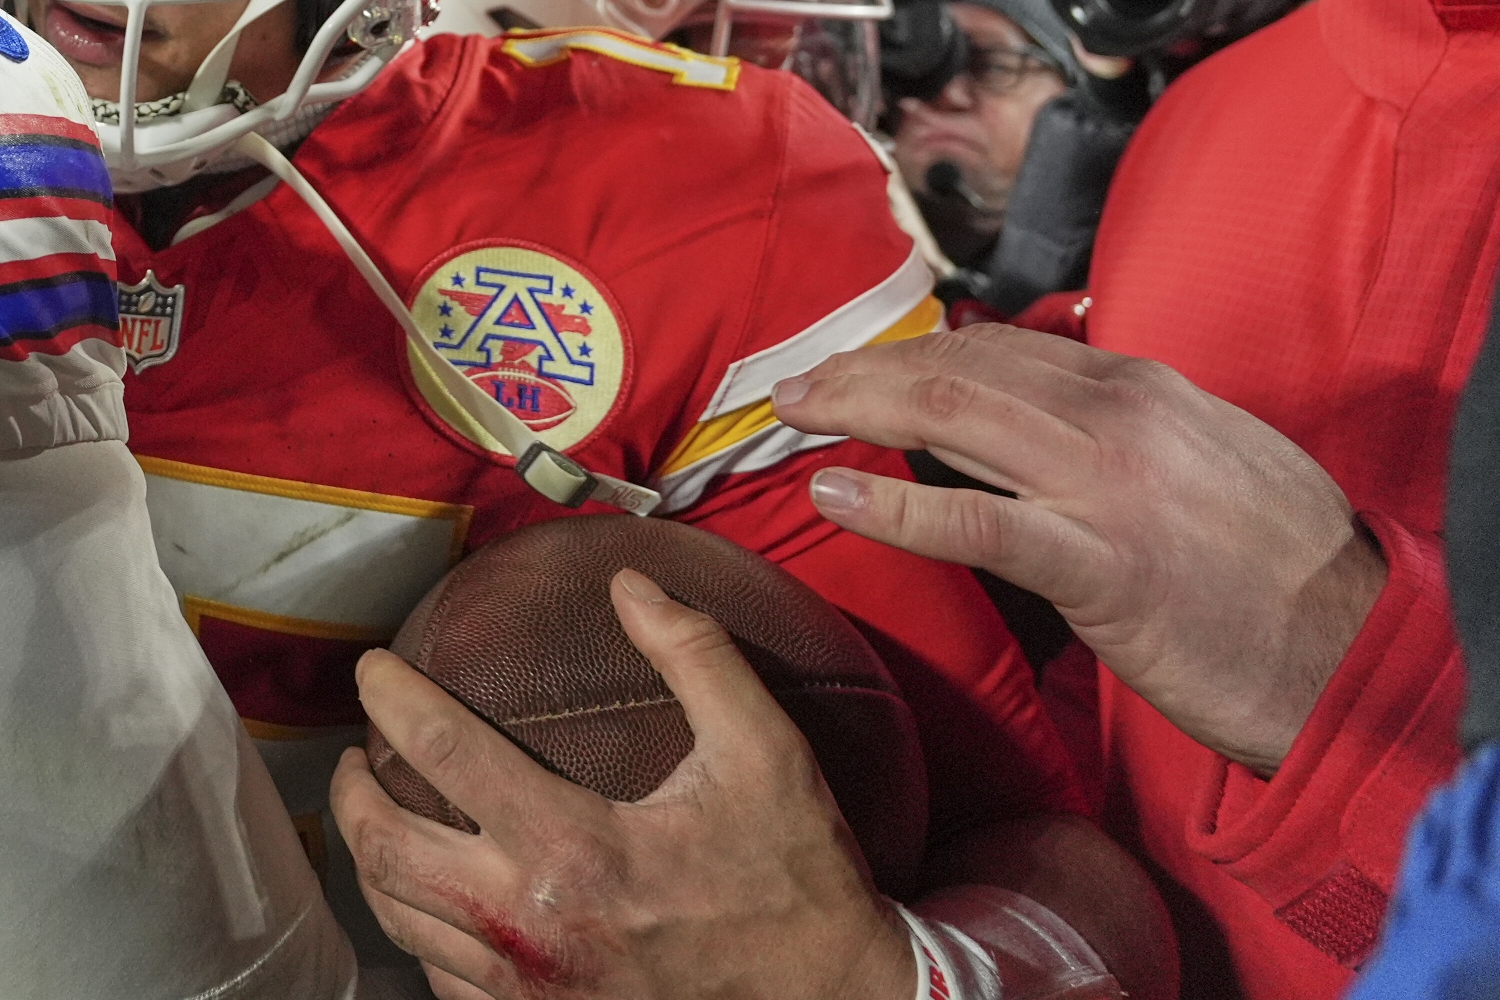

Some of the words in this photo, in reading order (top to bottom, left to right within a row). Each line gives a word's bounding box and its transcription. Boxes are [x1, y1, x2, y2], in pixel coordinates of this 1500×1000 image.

[118, 316, 165, 355] NFL
[434, 265, 595, 386] A
[491, 379, 542, 412] LH
